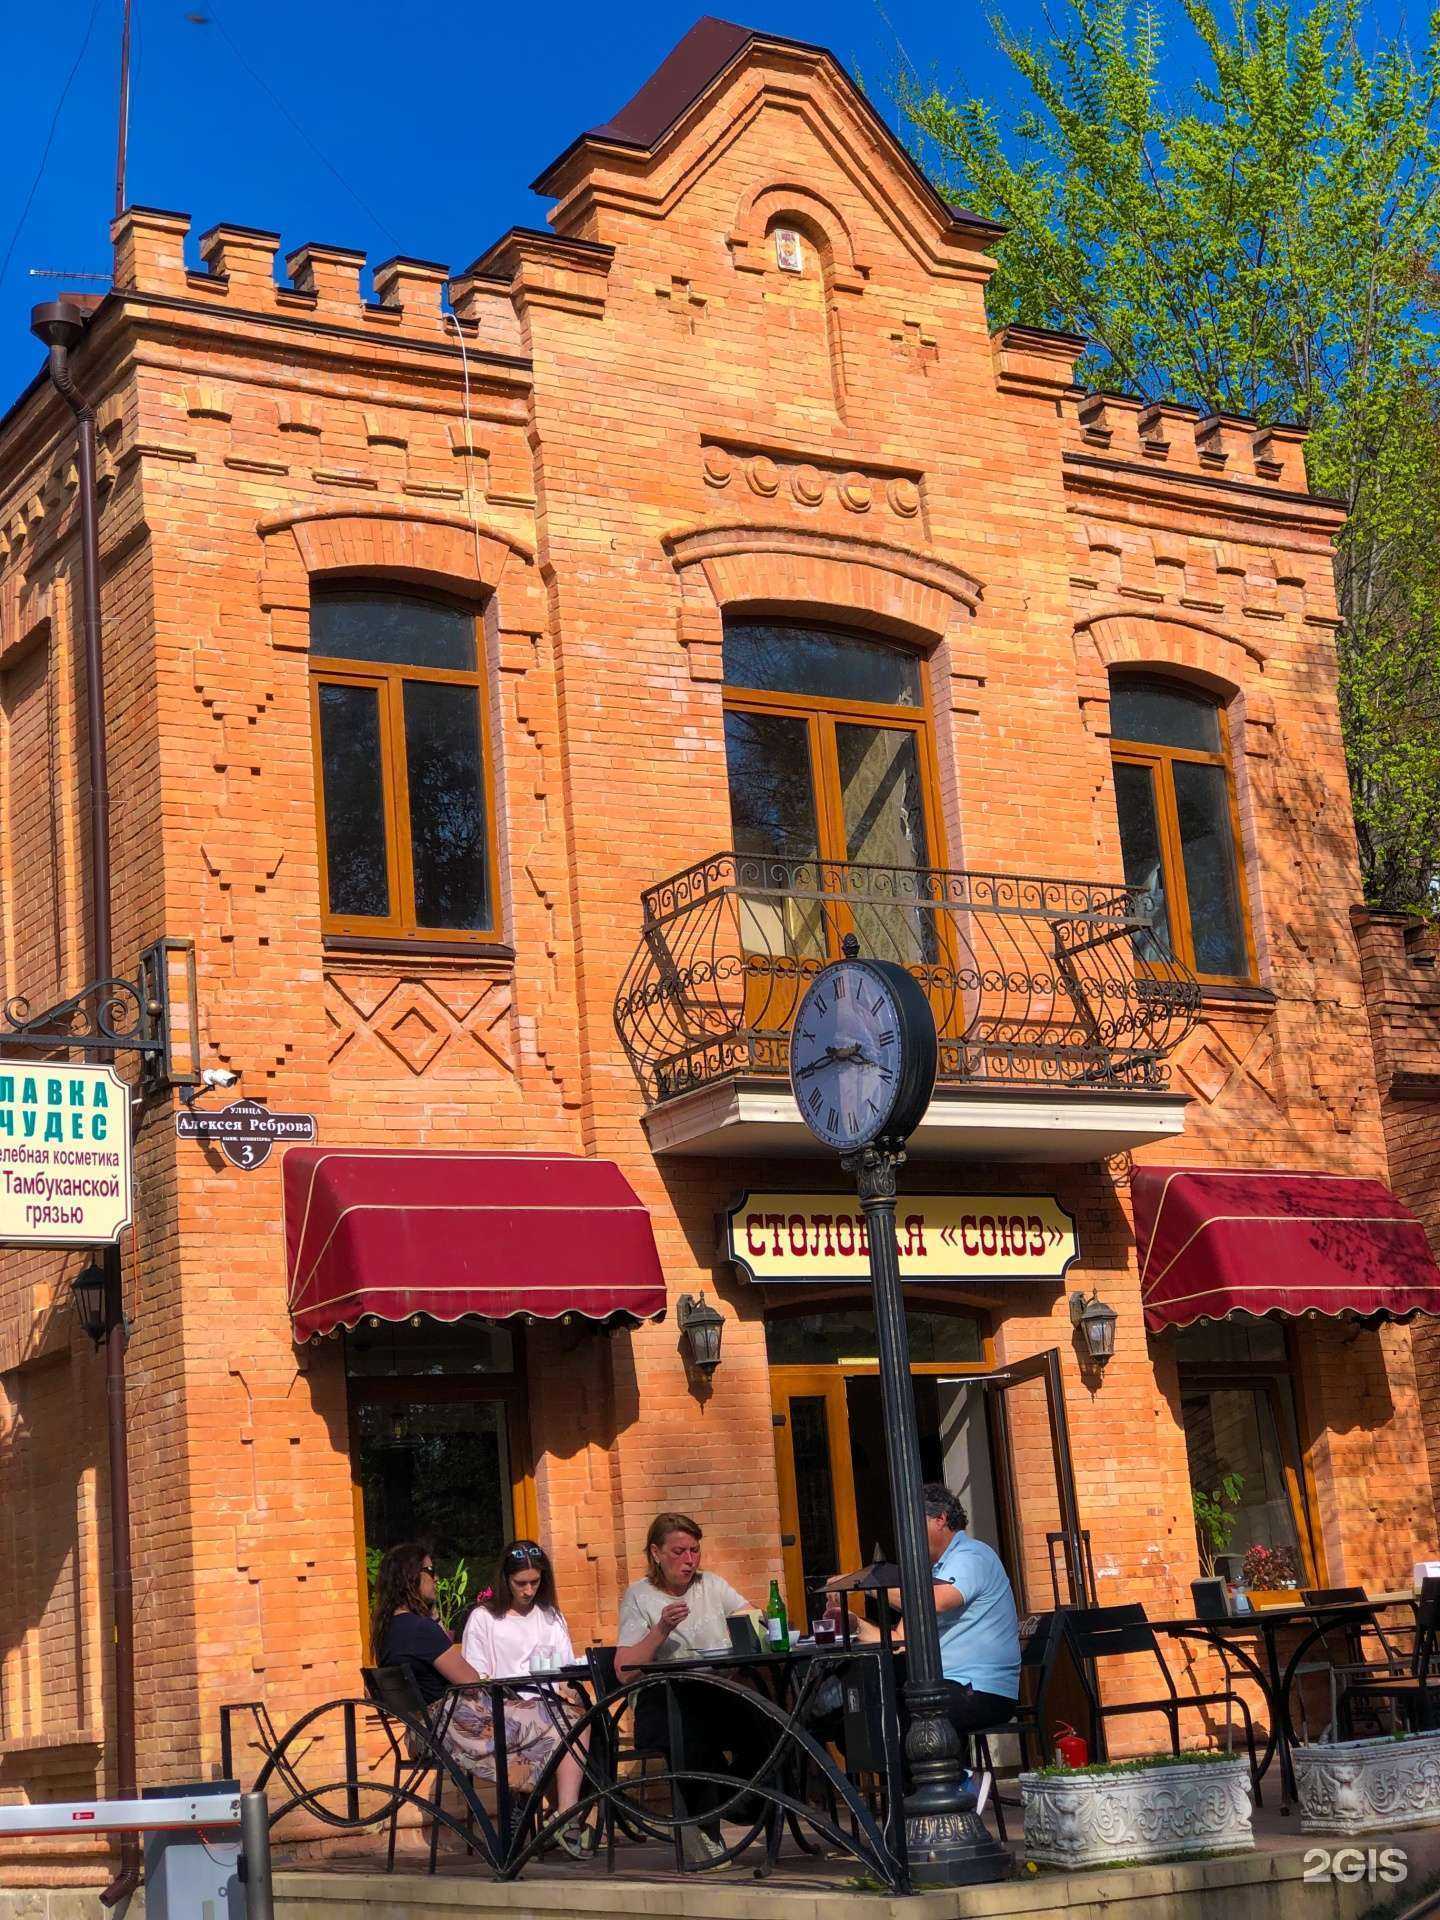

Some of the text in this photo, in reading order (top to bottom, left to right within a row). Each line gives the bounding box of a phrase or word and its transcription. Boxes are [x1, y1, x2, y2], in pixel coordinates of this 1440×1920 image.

[0, 1076, 109, 1108] ЛАВКА
[0, 1109, 107, 1142] ЧУДЕС
[179, 1118, 312, 1135] Алексея Реброва
[53, 1150, 119, 1167] косметика
[241, 1145, 254, 1165] 3
[3, 1170, 119, 1201] Тамбуканской
[26, 1205, 84, 1229] грязью
[940, 1215, 1064, 1257] «СОЮЗ»
